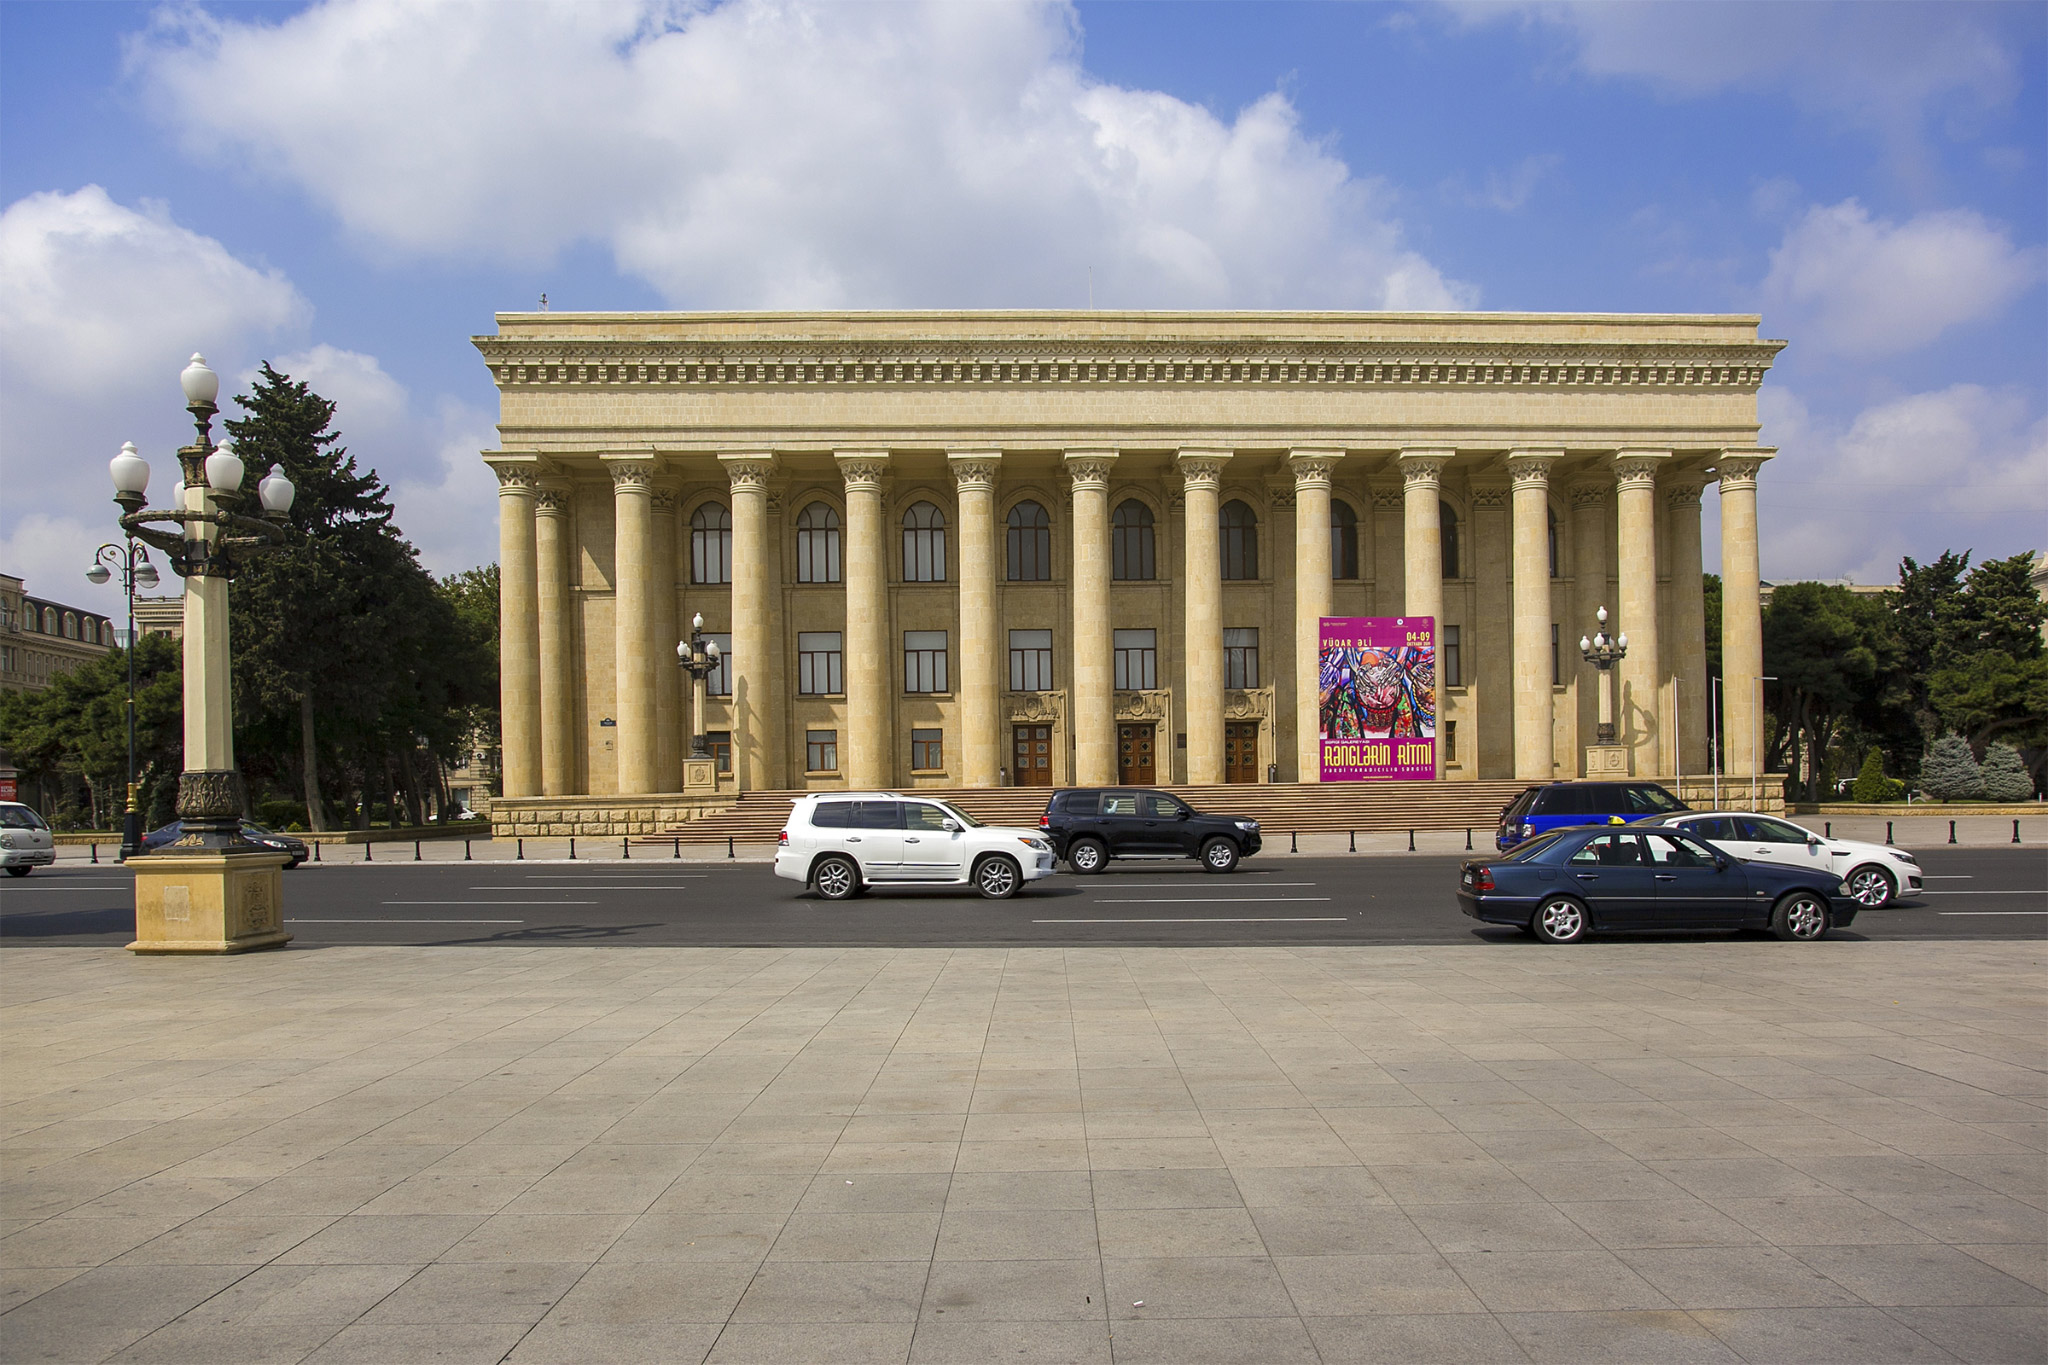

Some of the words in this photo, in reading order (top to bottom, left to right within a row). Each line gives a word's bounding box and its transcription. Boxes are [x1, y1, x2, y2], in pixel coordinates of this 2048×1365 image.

[1406, 631, 1430, 641] 04-09
[1322, 637, 1352, 646] VÜQAR
[1358, 637, 1372, 646] ƏLİ
[1324, 742, 1390, 766] RƏNGLƏRİN
[1397, 741, 1432, 766] RİTMİ
